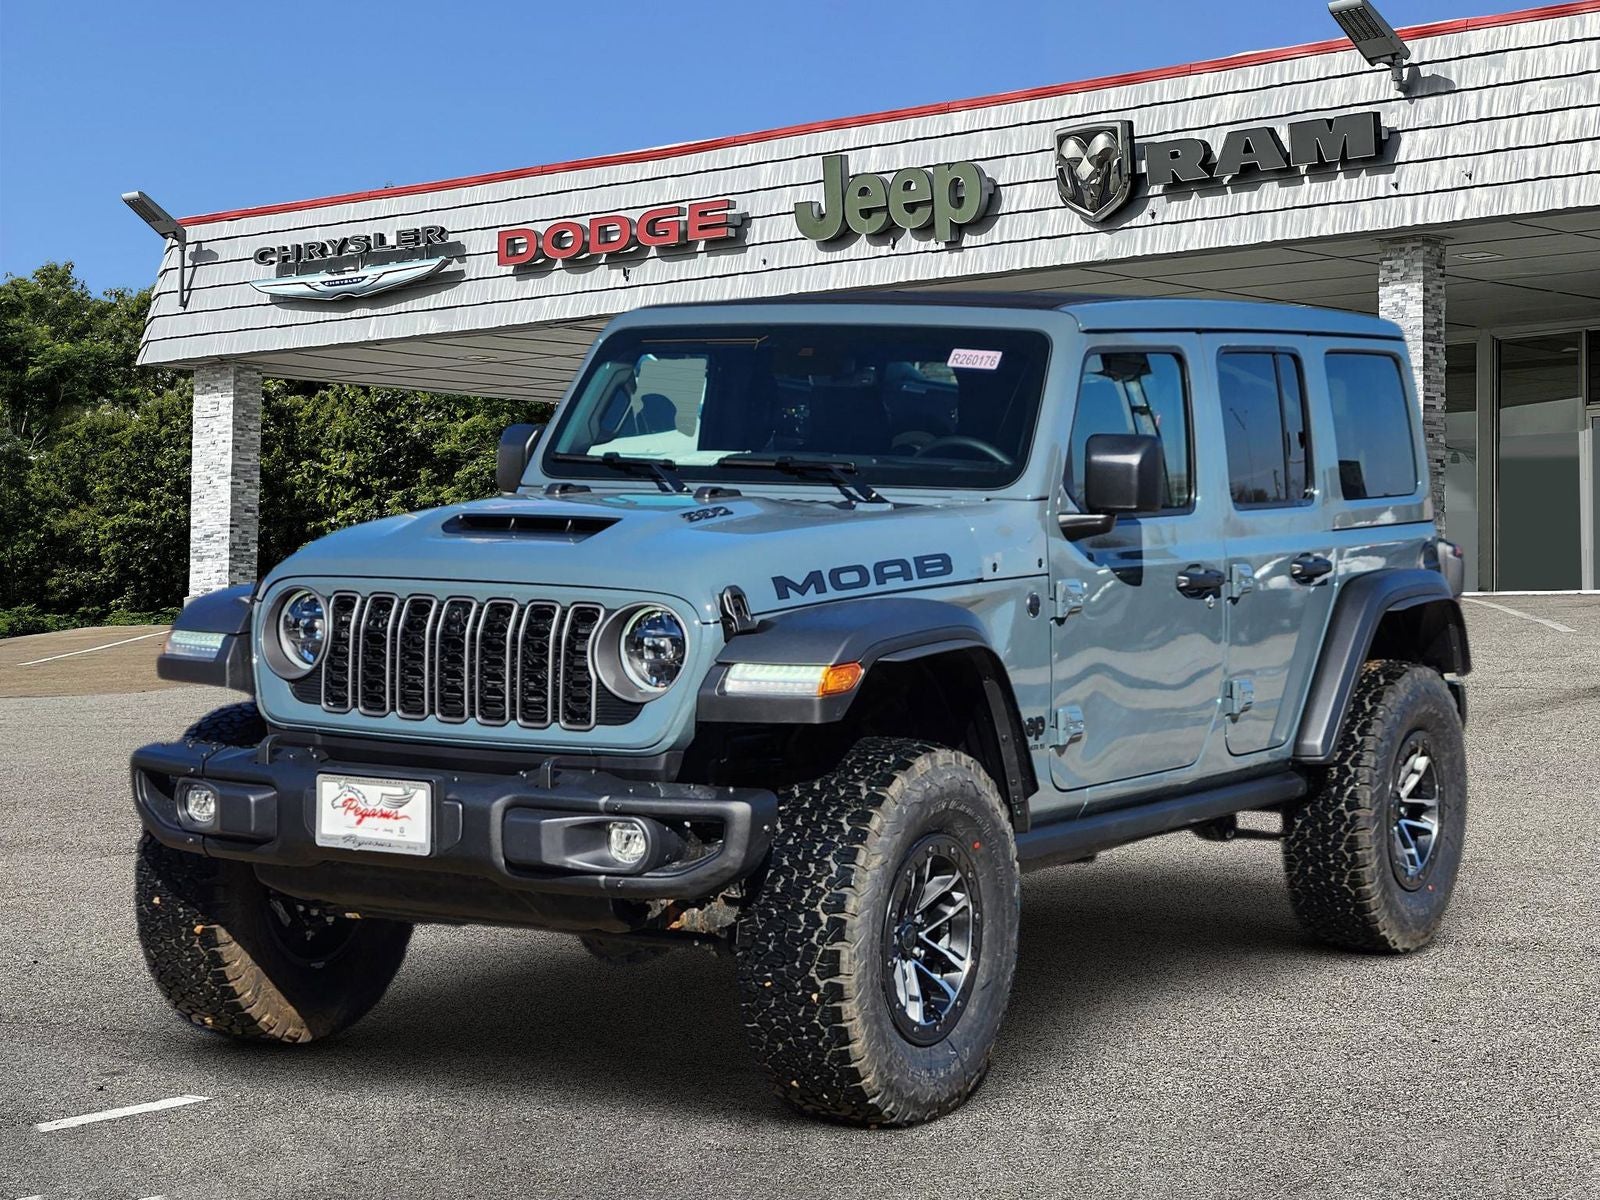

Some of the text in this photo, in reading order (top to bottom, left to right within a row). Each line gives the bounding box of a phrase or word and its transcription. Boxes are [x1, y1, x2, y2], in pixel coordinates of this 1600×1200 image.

[1145, 112, 1380, 186] RAM
[794, 154, 986, 242] Jeep
[253, 225, 449, 266] CHRYSLER
[497, 200, 736, 267] DODGE
[951, 353, 998, 367] R260176
[771, 553, 954, 601] MOAB
[342, 797, 412, 826] Pegasus
